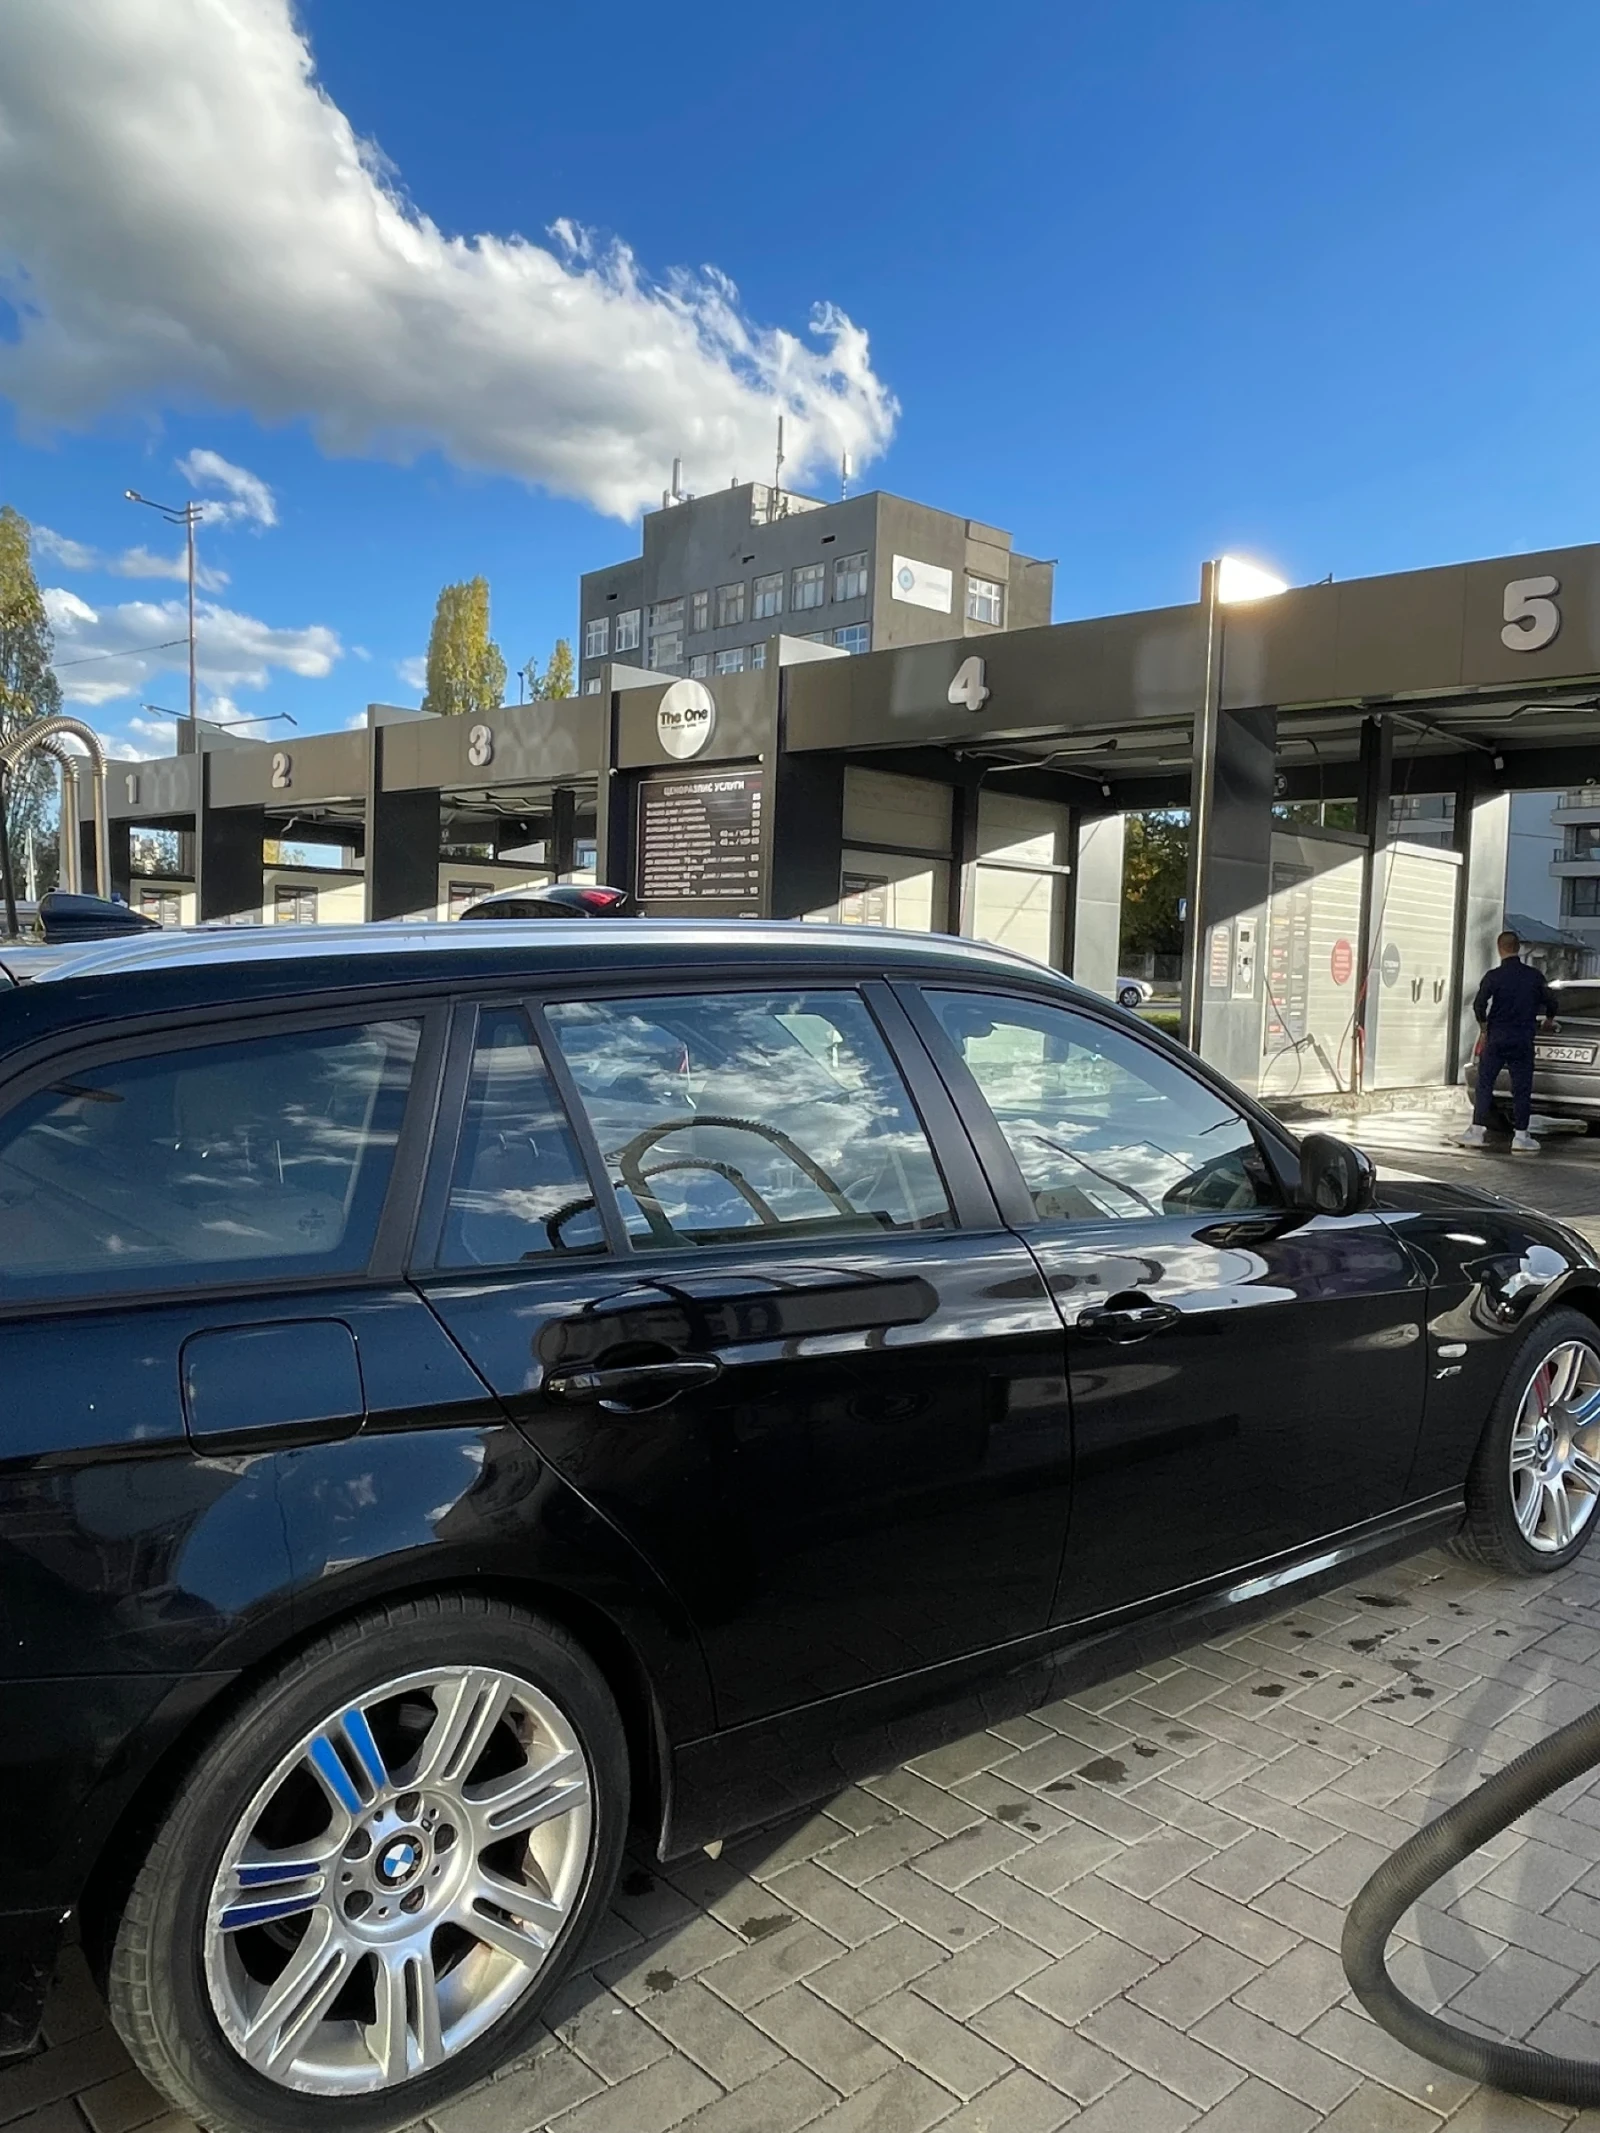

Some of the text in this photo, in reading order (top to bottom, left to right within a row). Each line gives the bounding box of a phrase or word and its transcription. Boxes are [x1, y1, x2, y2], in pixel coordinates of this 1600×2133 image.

[1501, 575, 1560, 651] 5
[948, 655, 990, 711] 4
[660, 708, 708, 725] The One
[468, 724, 492, 766] 3
[125, 774, 139, 804] 1
[272, 752, 292, 788] 2
